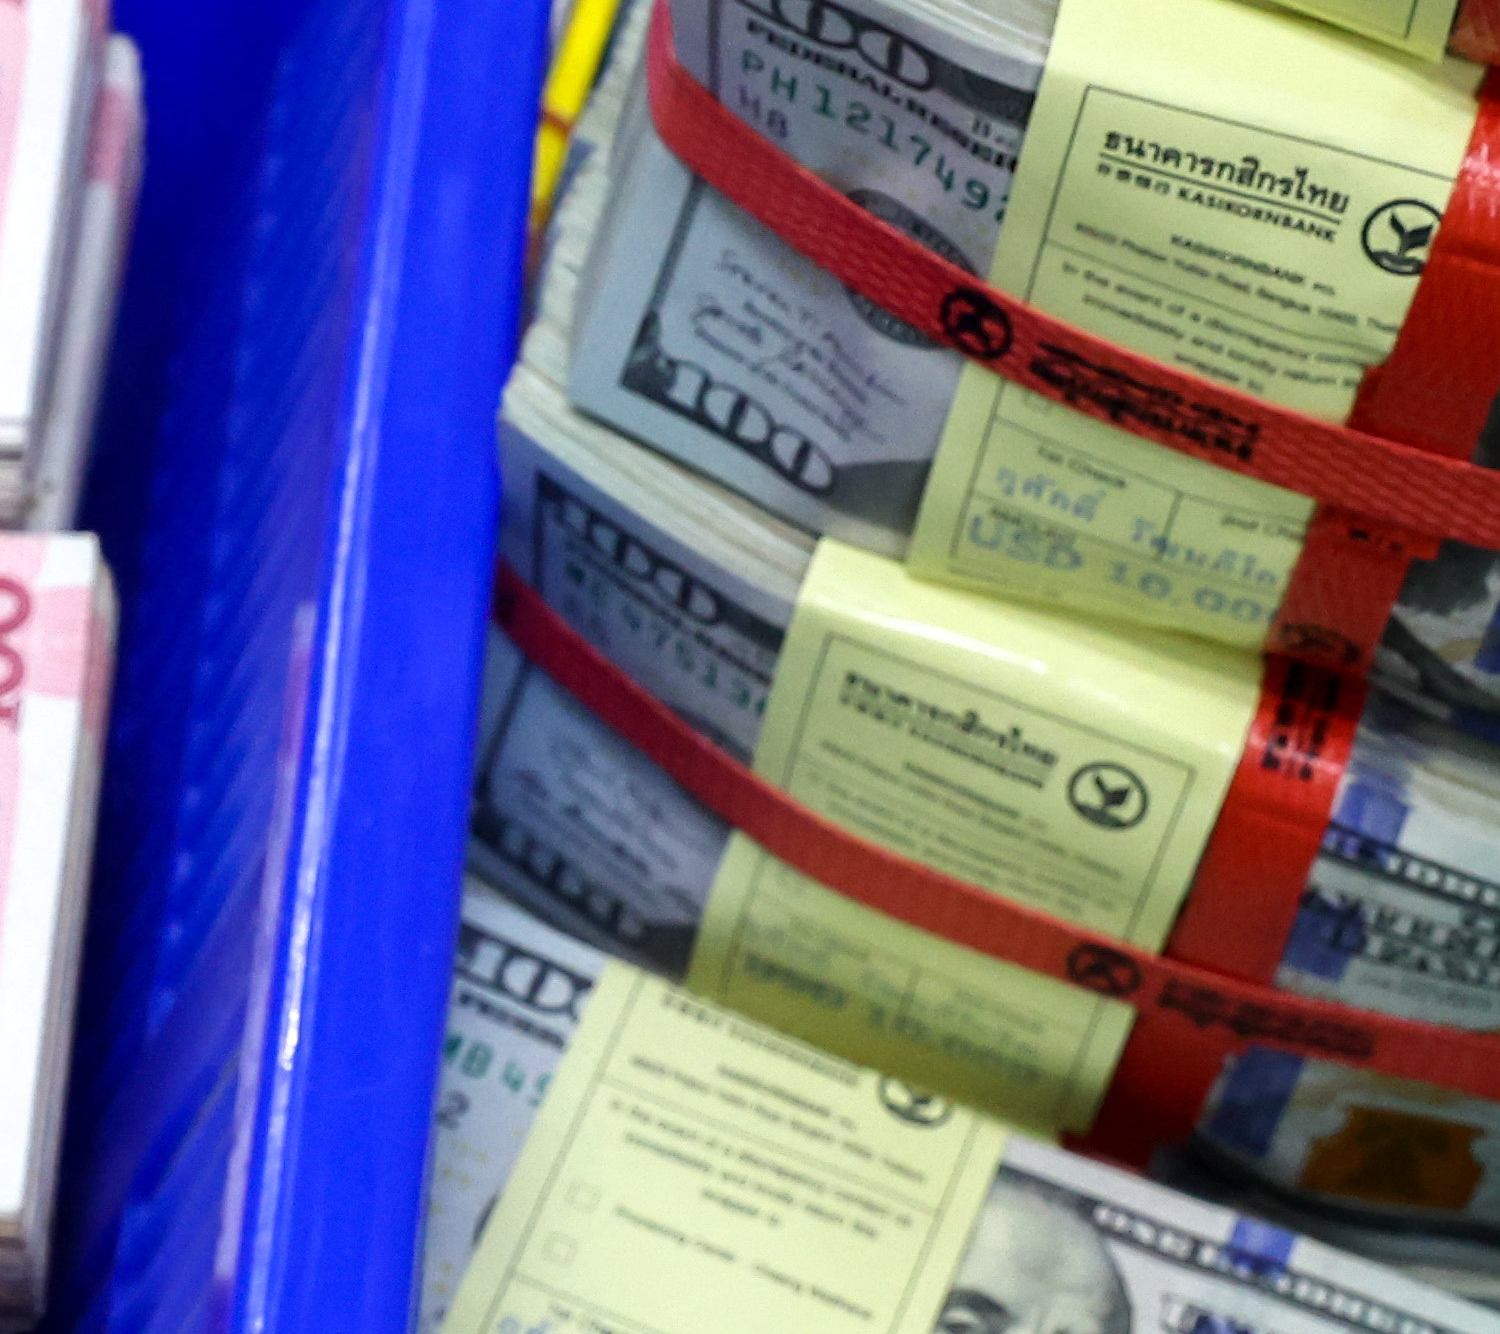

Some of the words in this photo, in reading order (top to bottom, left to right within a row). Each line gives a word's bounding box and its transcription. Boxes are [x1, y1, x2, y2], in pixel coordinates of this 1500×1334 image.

[1104, 130, 1350, 214] ธนาคารกสิกรไทย
[1177, 186, 1337, 244] KASIKORNBANK
[659, 357, 836, 497] 100
[969, 516, 1085, 571] USD
